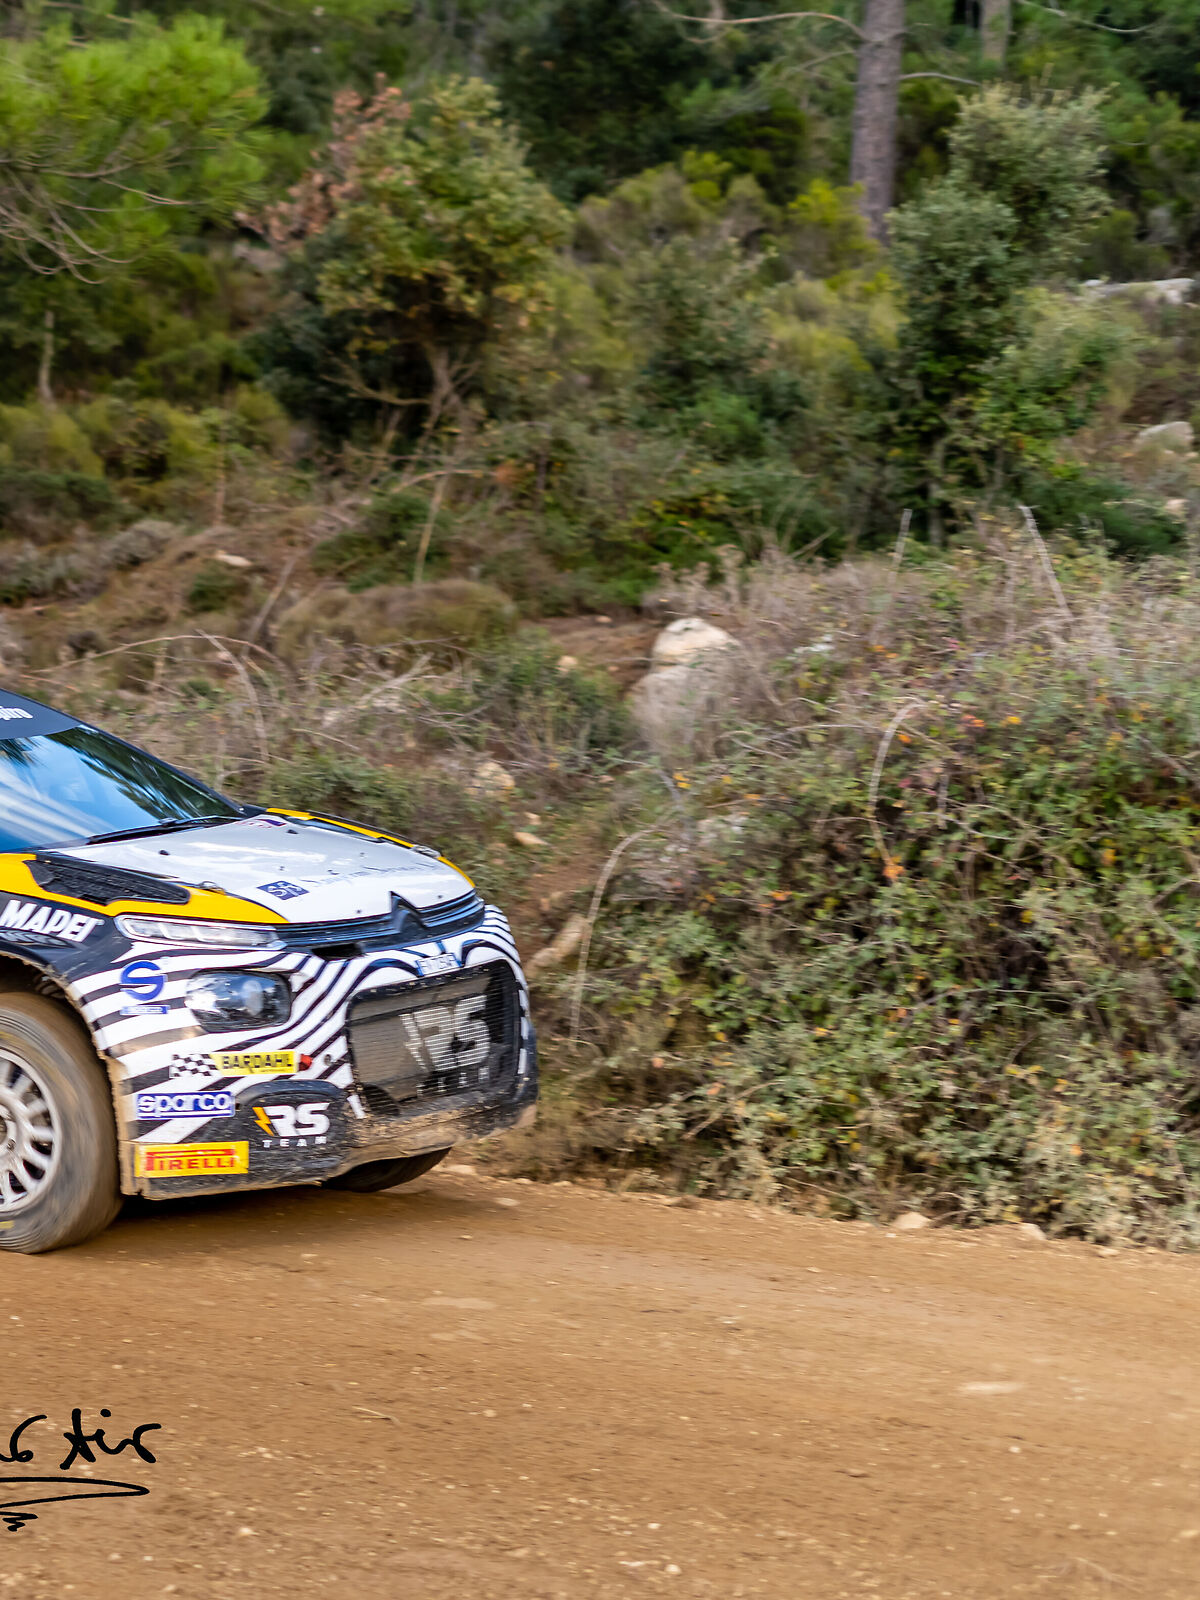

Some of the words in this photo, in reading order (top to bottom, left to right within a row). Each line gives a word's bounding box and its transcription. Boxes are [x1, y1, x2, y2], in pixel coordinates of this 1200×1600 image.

[223, 1054, 293, 1073] BARDAHL
[138, 1094, 230, 1115] sparco
[262, 1102, 331, 1137] RS
[262, 1136, 327, 1148] TEAM
[145, 1149, 235, 1172] PIRELLI
